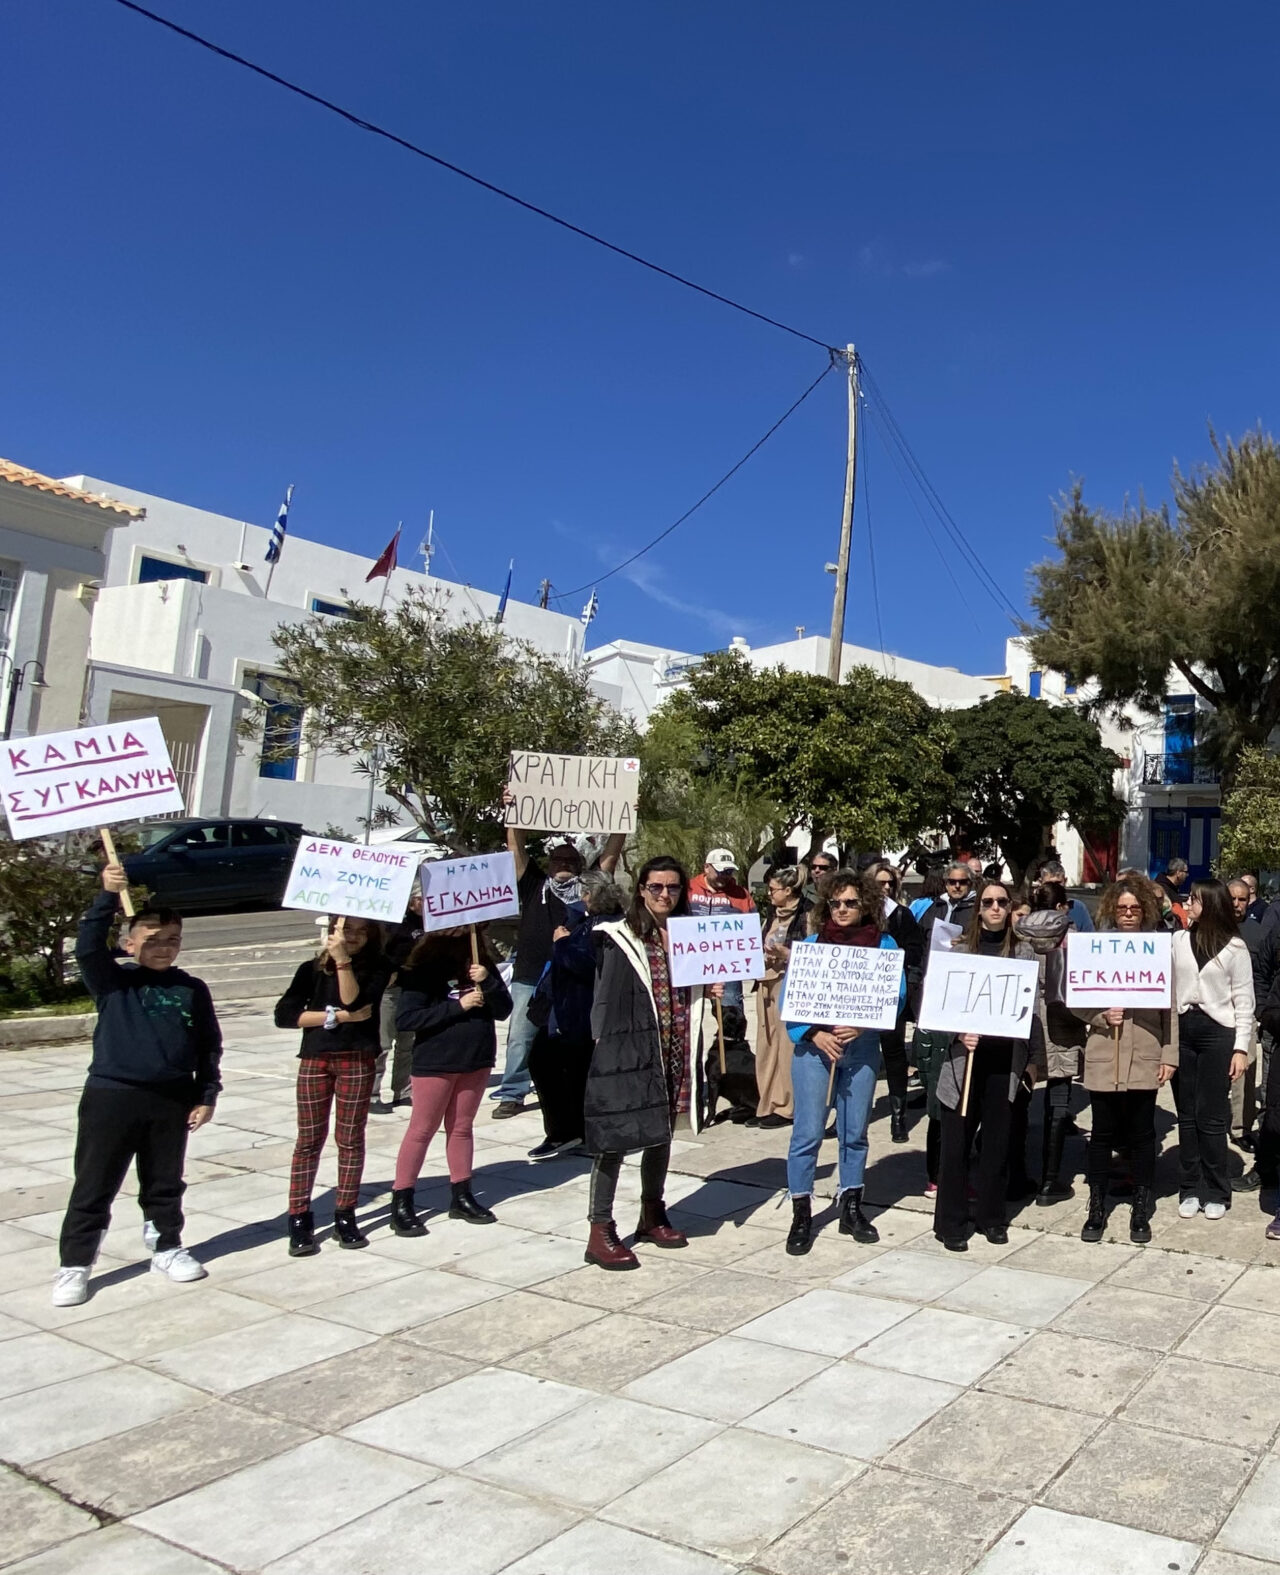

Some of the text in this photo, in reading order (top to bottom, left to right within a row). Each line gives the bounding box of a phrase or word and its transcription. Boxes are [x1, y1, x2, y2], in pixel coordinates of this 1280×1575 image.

[8, 732, 144, 769] ΚΑΜΙΑ
[509, 753, 618, 789] ΚΡΑΤΙΚΗ
[8, 767, 176, 812] ΣΥΓΚΑΛΥΨΗ
[505, 794, 632, 830] ΔΟΛΟΦΟΝΙΑ
[305, 842, 410, 868] ΔΕΝ ΘΕΛΟΥΜΕ
[447, 862, 489, 876] ΗΤΑΝ
[300, 866, 391, 891] ΝΑ ΖΟΥΜΕ
[293, 889, 393, 915] ΑΠΟ ΤΥΧΗ
[426, 884, 514, 913] ΕΓΚΛΗΜΑ
[697, 920, 744, 933] ΗΤΑΝ
[672, 937, 761, 956] ΜΑΘΗΤΕΣ
[796, 944, 825, 955] ΗΤΑΝ
[831, 946, 841, 958] Ο
[847, 948, 870, 960] ΓΙΟΣ
[1091, 939, 1155, 955] ΗΤΑΝ
[702, 958, 752, 976] ΜΑΣ!
[793, 957, 823, 969] ΗΤΑΝ
[828, 958, 839, 970] Ο
[841, 960, 870, 971] ΦΙΛΟΣ
[791, 968, 819, 979] ΗΤΑΝ
[822, 970, 828, 980] Η
[1069, 970, 1166, 985] ΕΓΚΛΗΜΑ
[789, 980, 817, 990] ΗΤΑΝ
[820, 981, 832, 992] ΤΑ
[836, 982, 867, 994] ΠΑΙΔΙΑ
[787, 991, 815, 1001] ΗΤΑΝ
[817, 993, 827, 1002] ΟΙ
[830, 994, 873, 1005] ΜΑΘΗΤΕΣ
[941, 970, 1032, 1023] ΓΙΑΤΙ;
[794, 1009, 812, 1018] ΠΟΥ
[812, 1011, 830, 1019] ΜΑΣ
